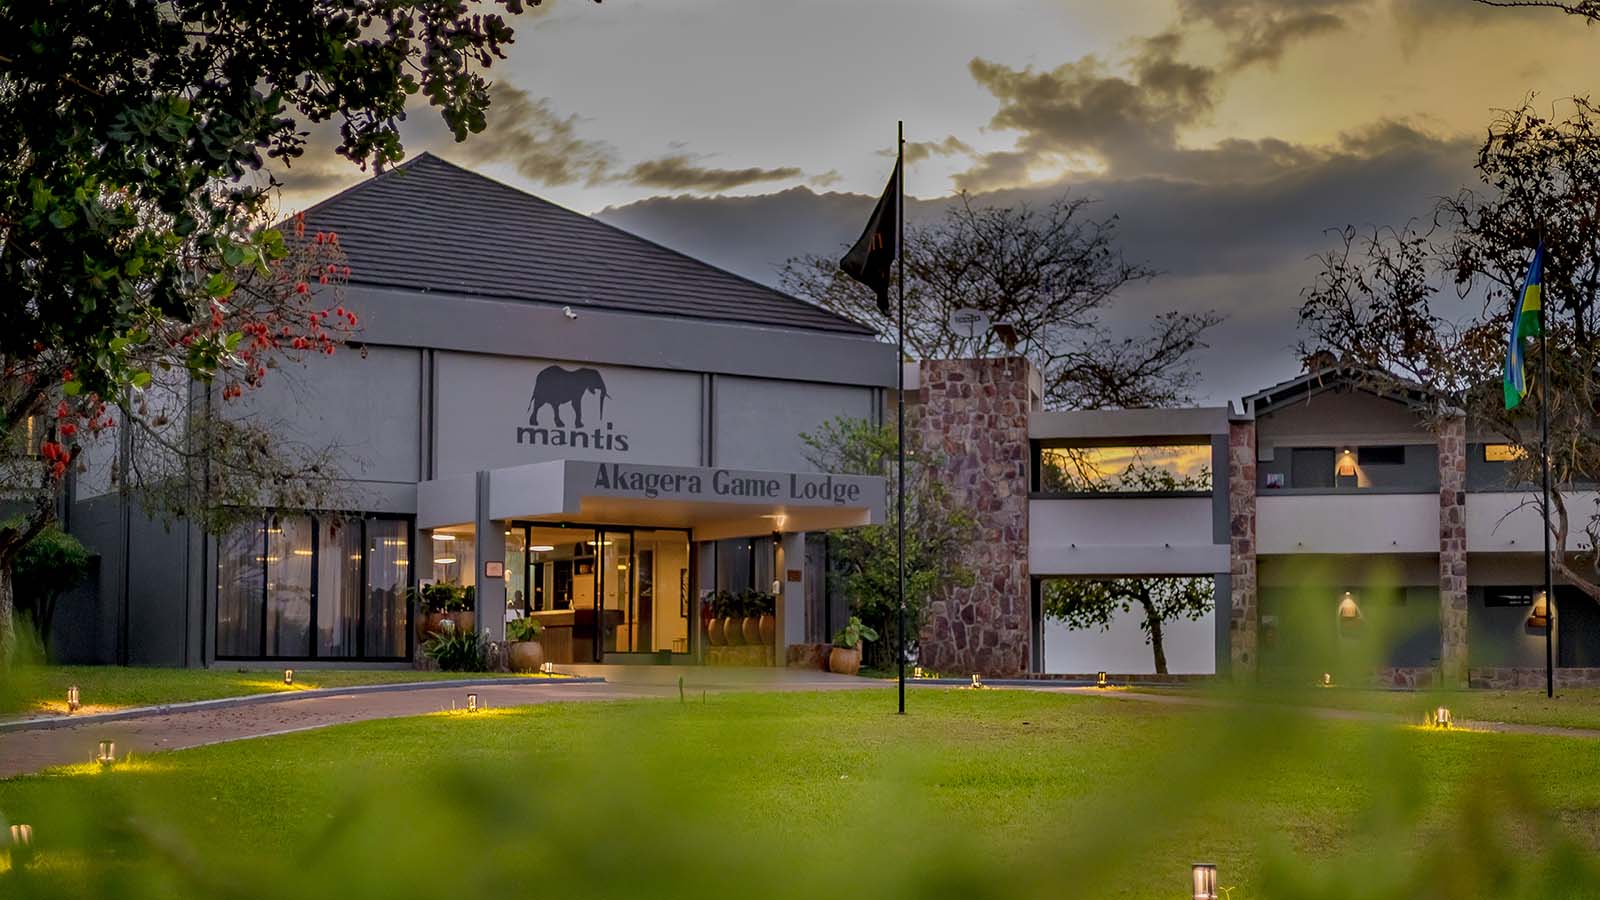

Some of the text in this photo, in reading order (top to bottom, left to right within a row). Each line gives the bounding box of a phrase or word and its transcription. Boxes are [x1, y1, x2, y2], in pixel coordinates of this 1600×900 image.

[516, 422, 629, 451] mantis
[594, 463, 860, 504] Akagera Game Lodge
